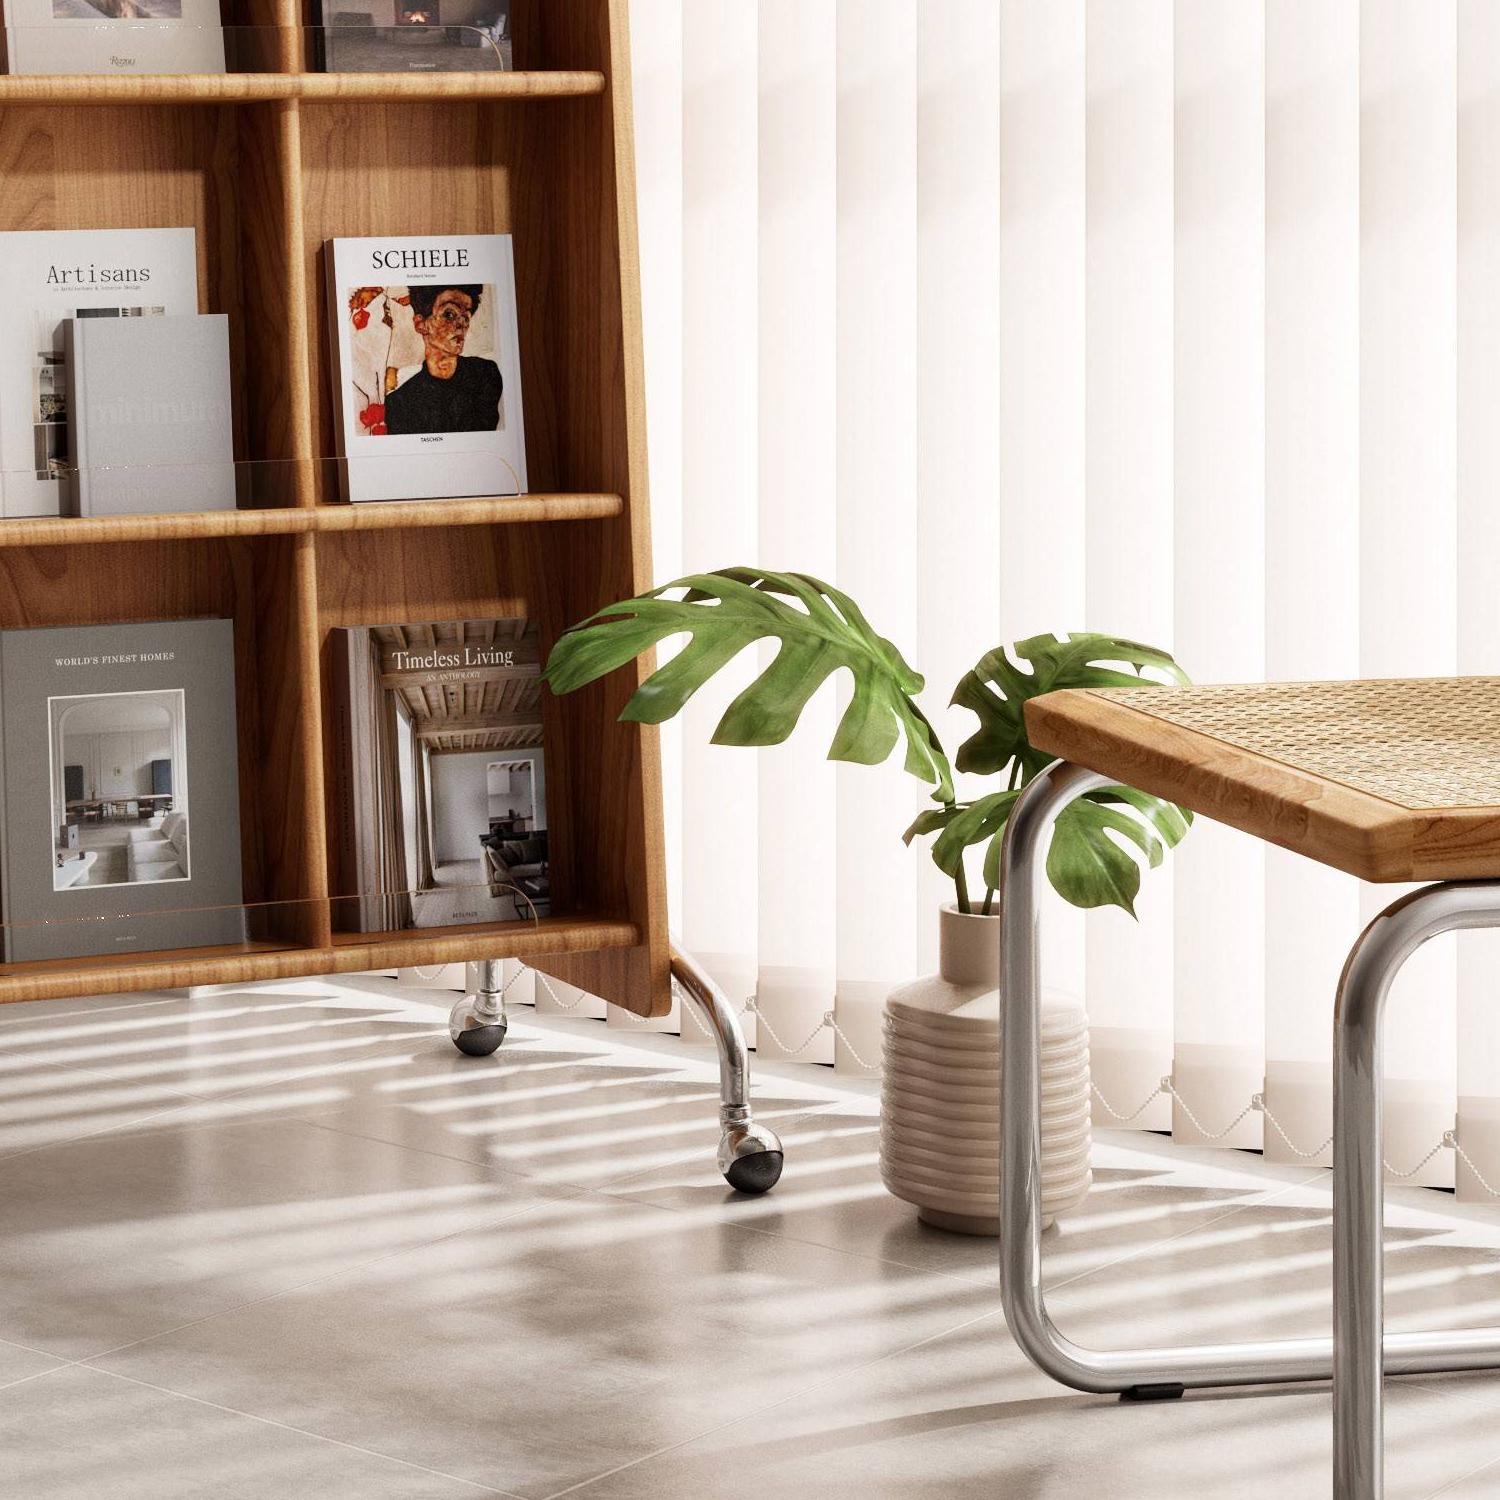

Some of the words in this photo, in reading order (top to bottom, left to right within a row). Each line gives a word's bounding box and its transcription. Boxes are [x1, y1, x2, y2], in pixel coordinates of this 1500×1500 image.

[372, 248, 470, 269] SCHIELE
[46, 263, 151, 284] Artisans
[54, 656, 100, 667] WORLD'S
[101, 653, 138, 664] FINEST
[140, 651, 175, 662] HOMES
[392, 650, 461, 670] Timeless
[463, 646, 514, 668] Living
